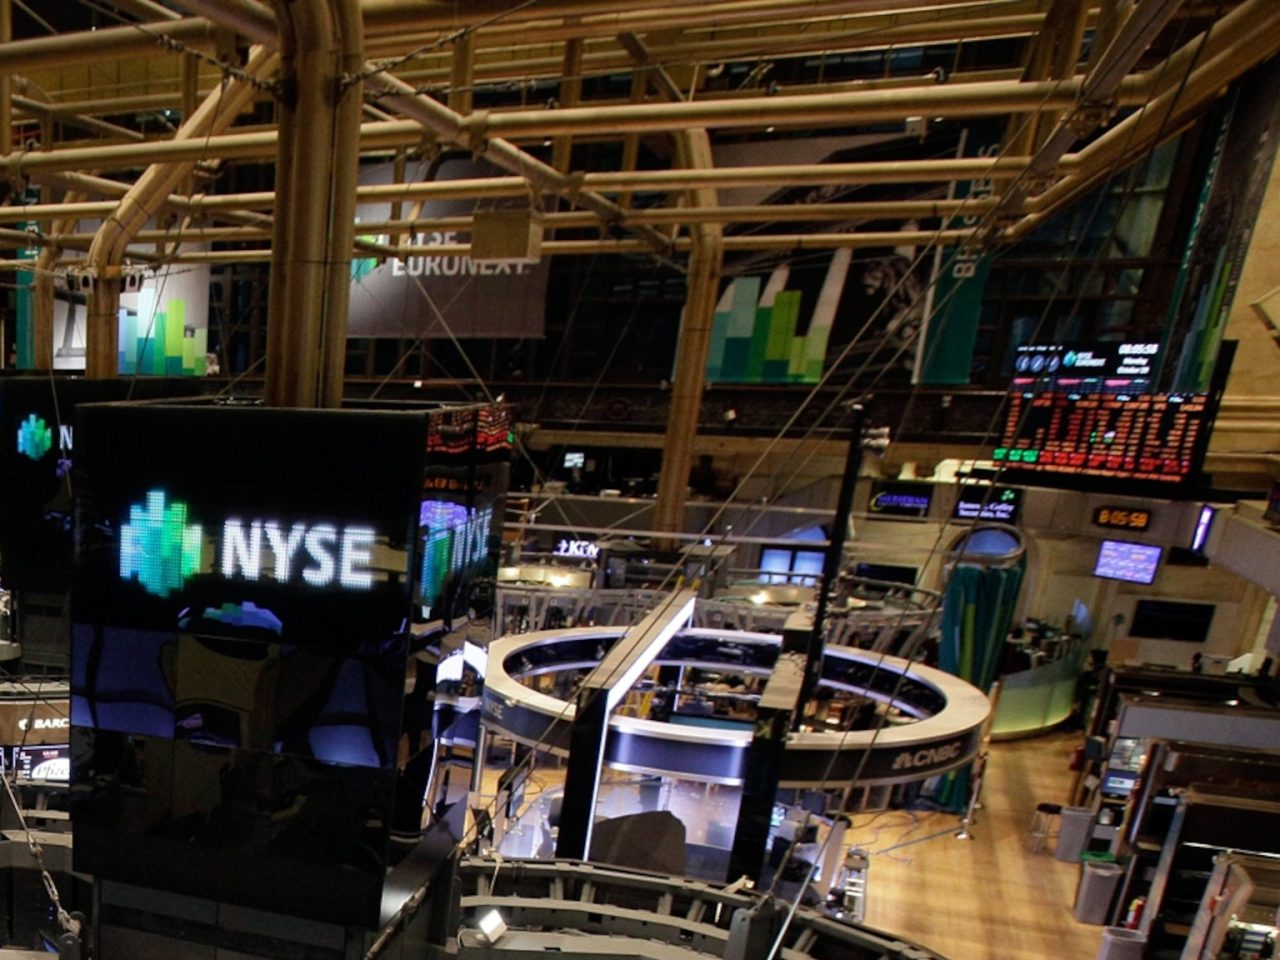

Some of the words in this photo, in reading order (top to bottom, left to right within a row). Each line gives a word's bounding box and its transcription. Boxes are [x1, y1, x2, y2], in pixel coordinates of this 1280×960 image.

[222, 518, 376, 590] NYSE
[34, 718, 70, 728] BARC
[912, 741, 963, 767] CNBC
